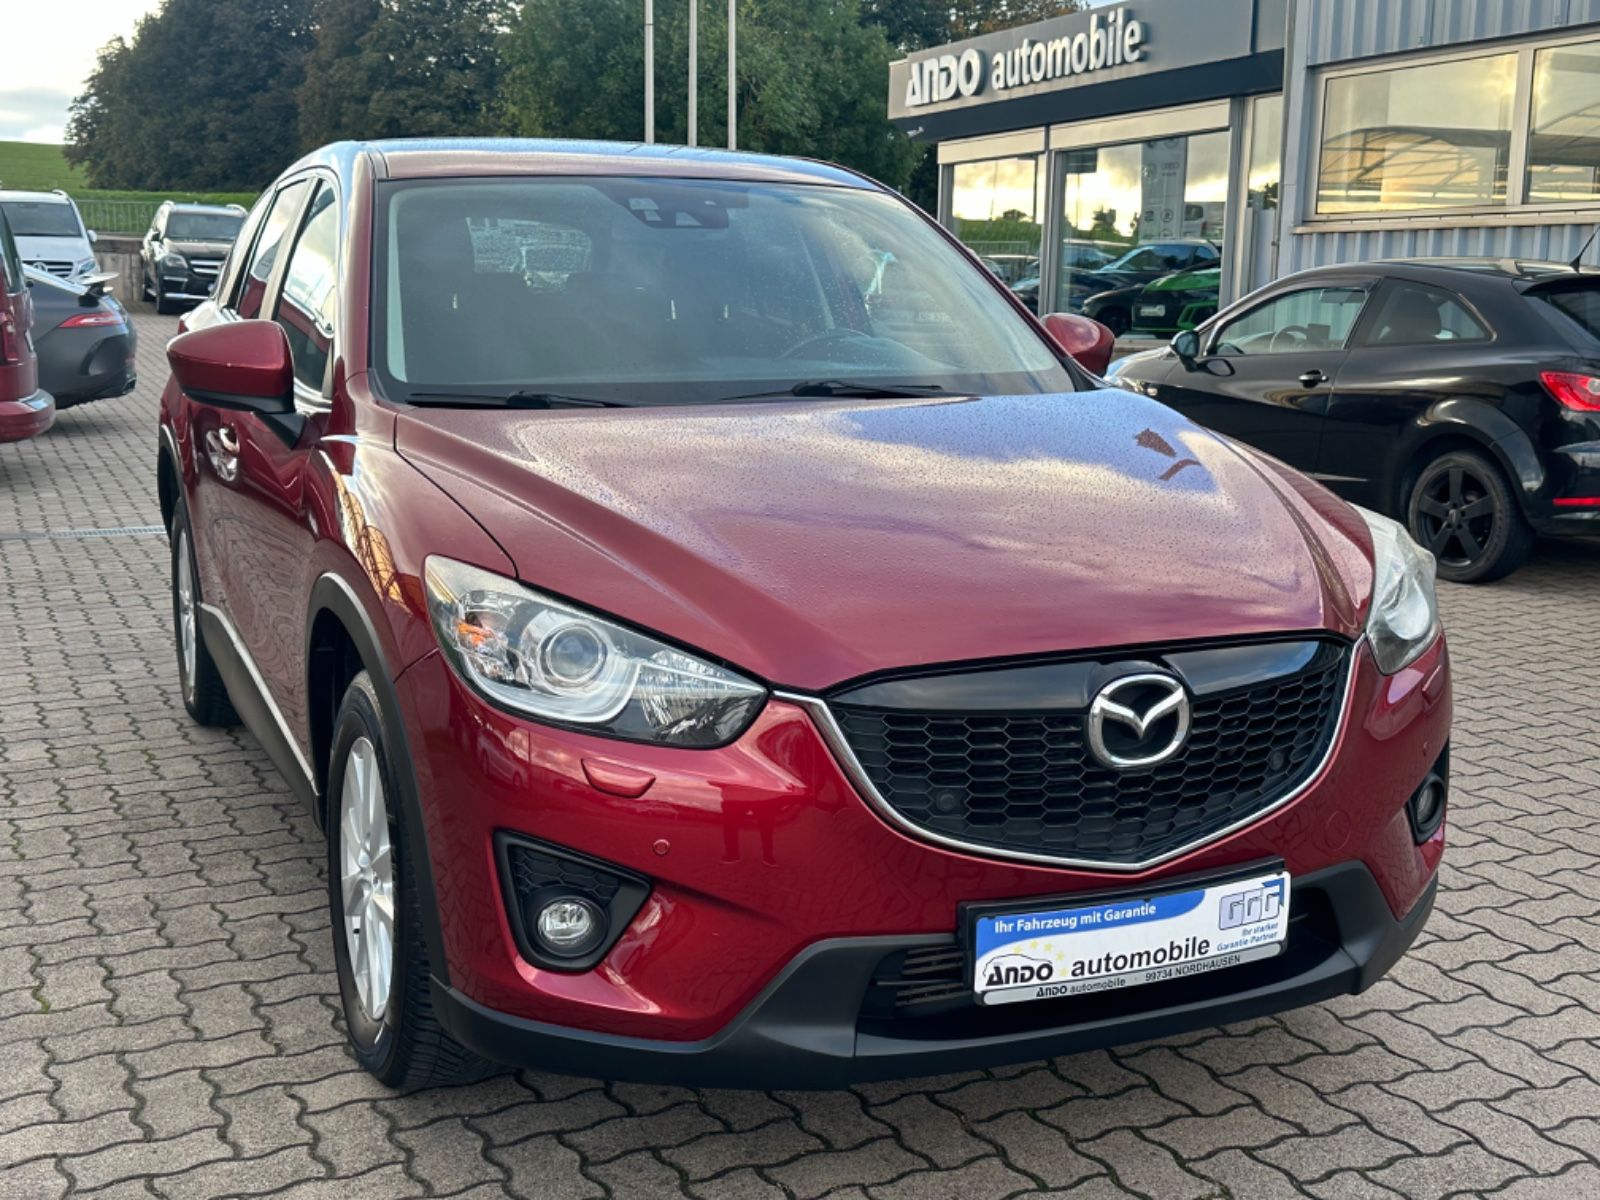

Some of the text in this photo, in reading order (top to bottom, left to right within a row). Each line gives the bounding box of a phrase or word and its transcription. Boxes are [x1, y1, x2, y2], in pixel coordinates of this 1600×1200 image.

[905, 7, 1142, 107] ANDO automobile
[995, 903, 1157, 933] Ihr Fahrzeug mit Garantie
[1217, 931, 1278, 951] Garantie Partner
[985, 936, 1210, 987] ANDO automobile
[1145, 953, 1241, 982] 99734 NORDHAUSEN
[1036, 977, 1126, 998] ANDO automobile
